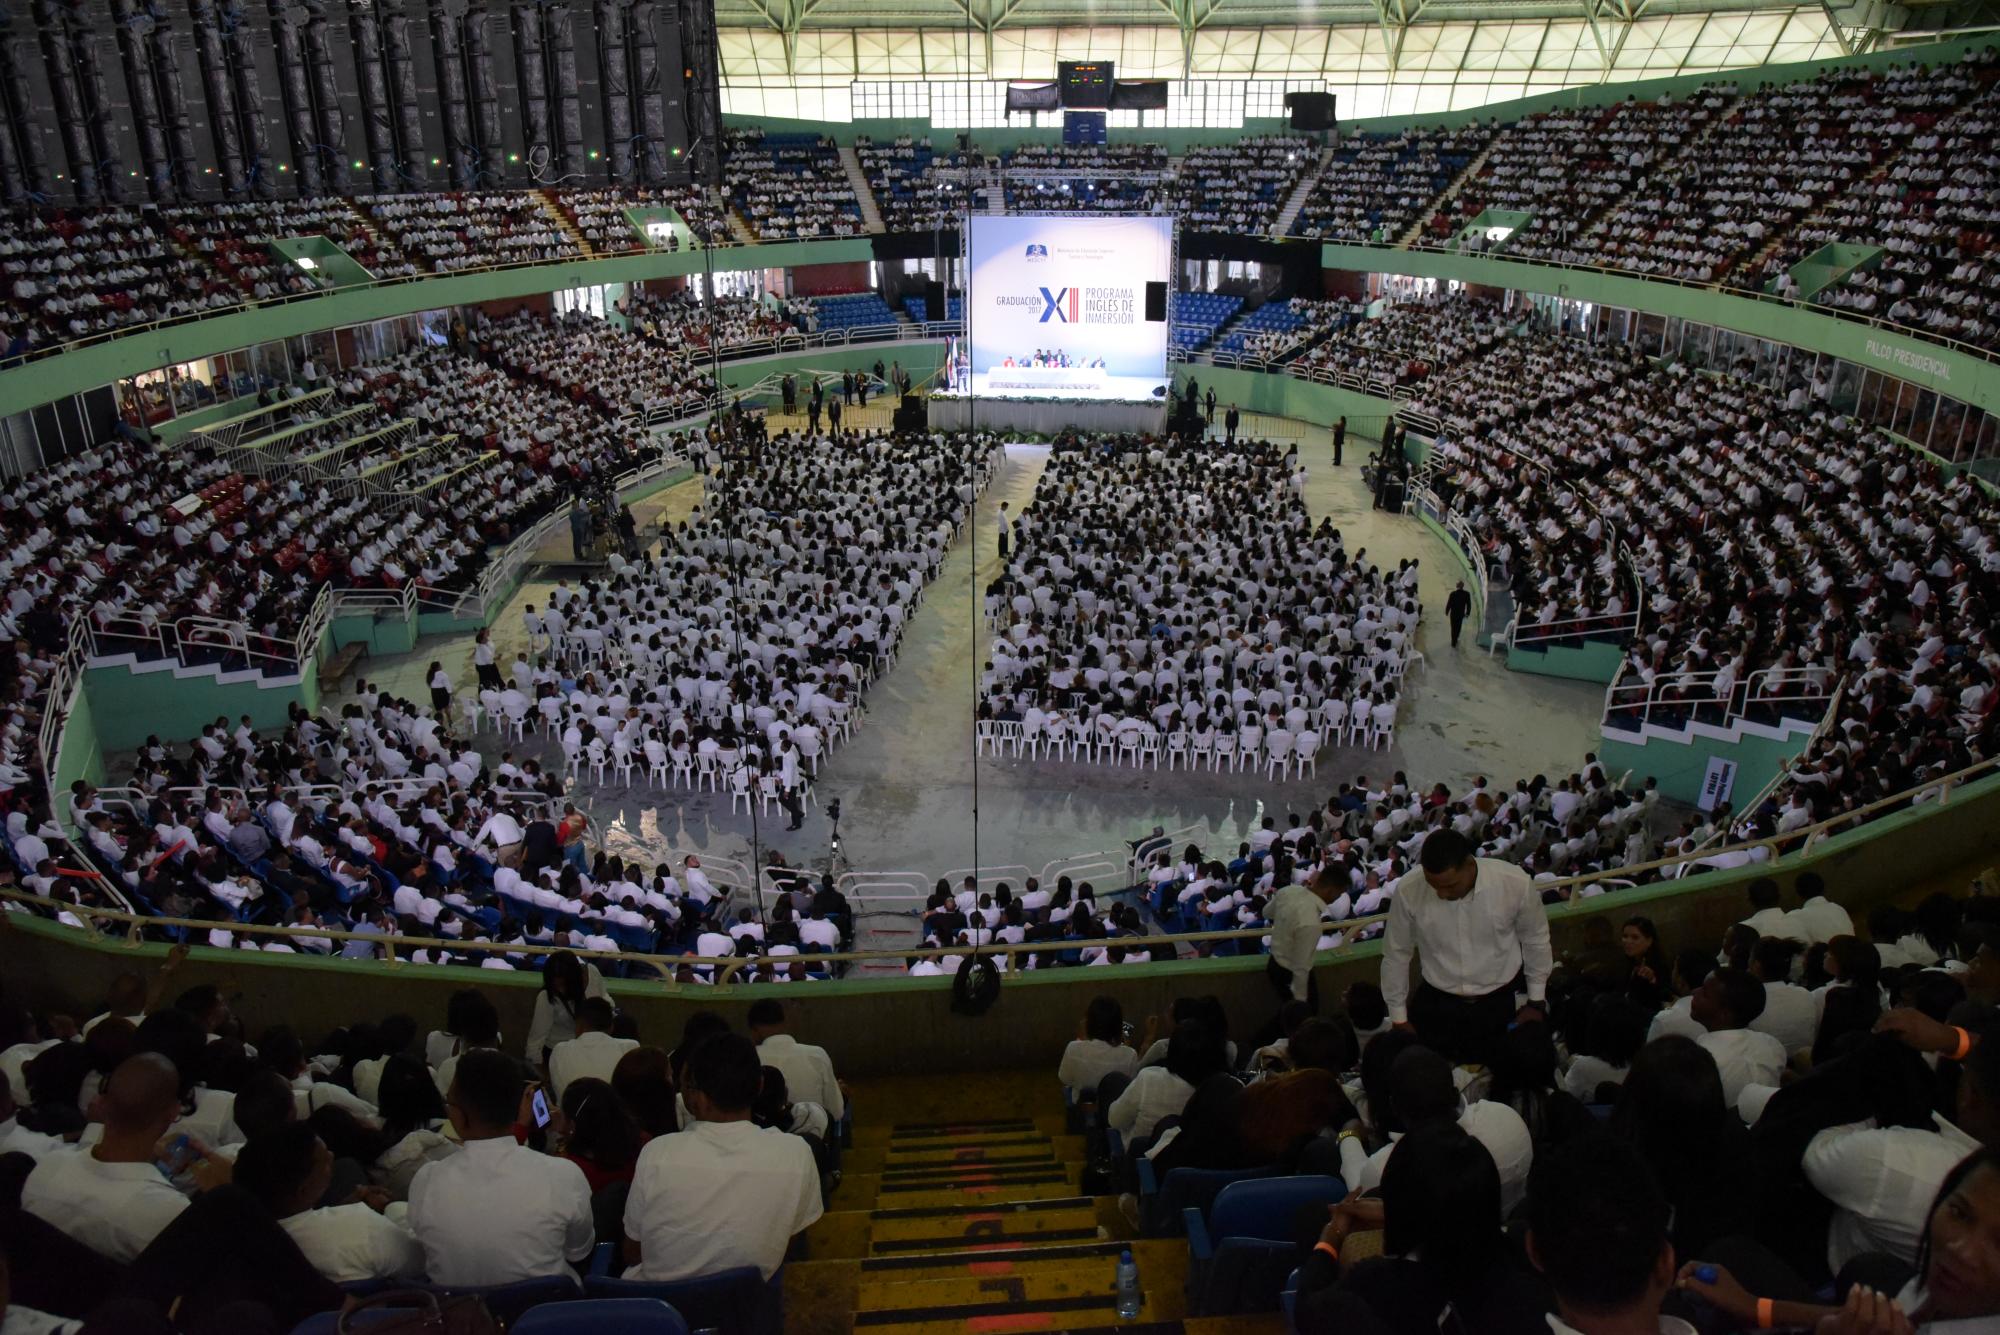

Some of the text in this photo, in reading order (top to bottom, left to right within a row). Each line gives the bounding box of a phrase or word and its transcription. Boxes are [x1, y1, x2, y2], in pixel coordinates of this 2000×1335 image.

[1086, 288, 1133, 299] PROGRAMA
[997, 294, 1042, 306] GRADUACIÓN
[1086, 299, 1134, 312] INGLÉS DE
[1028, 306, 1042, 314] 2017
[1086, 312, 1134, 325] INMERSIÓN
[1866, 340, 1950, 380] PALCO PRESIDENCIAL
